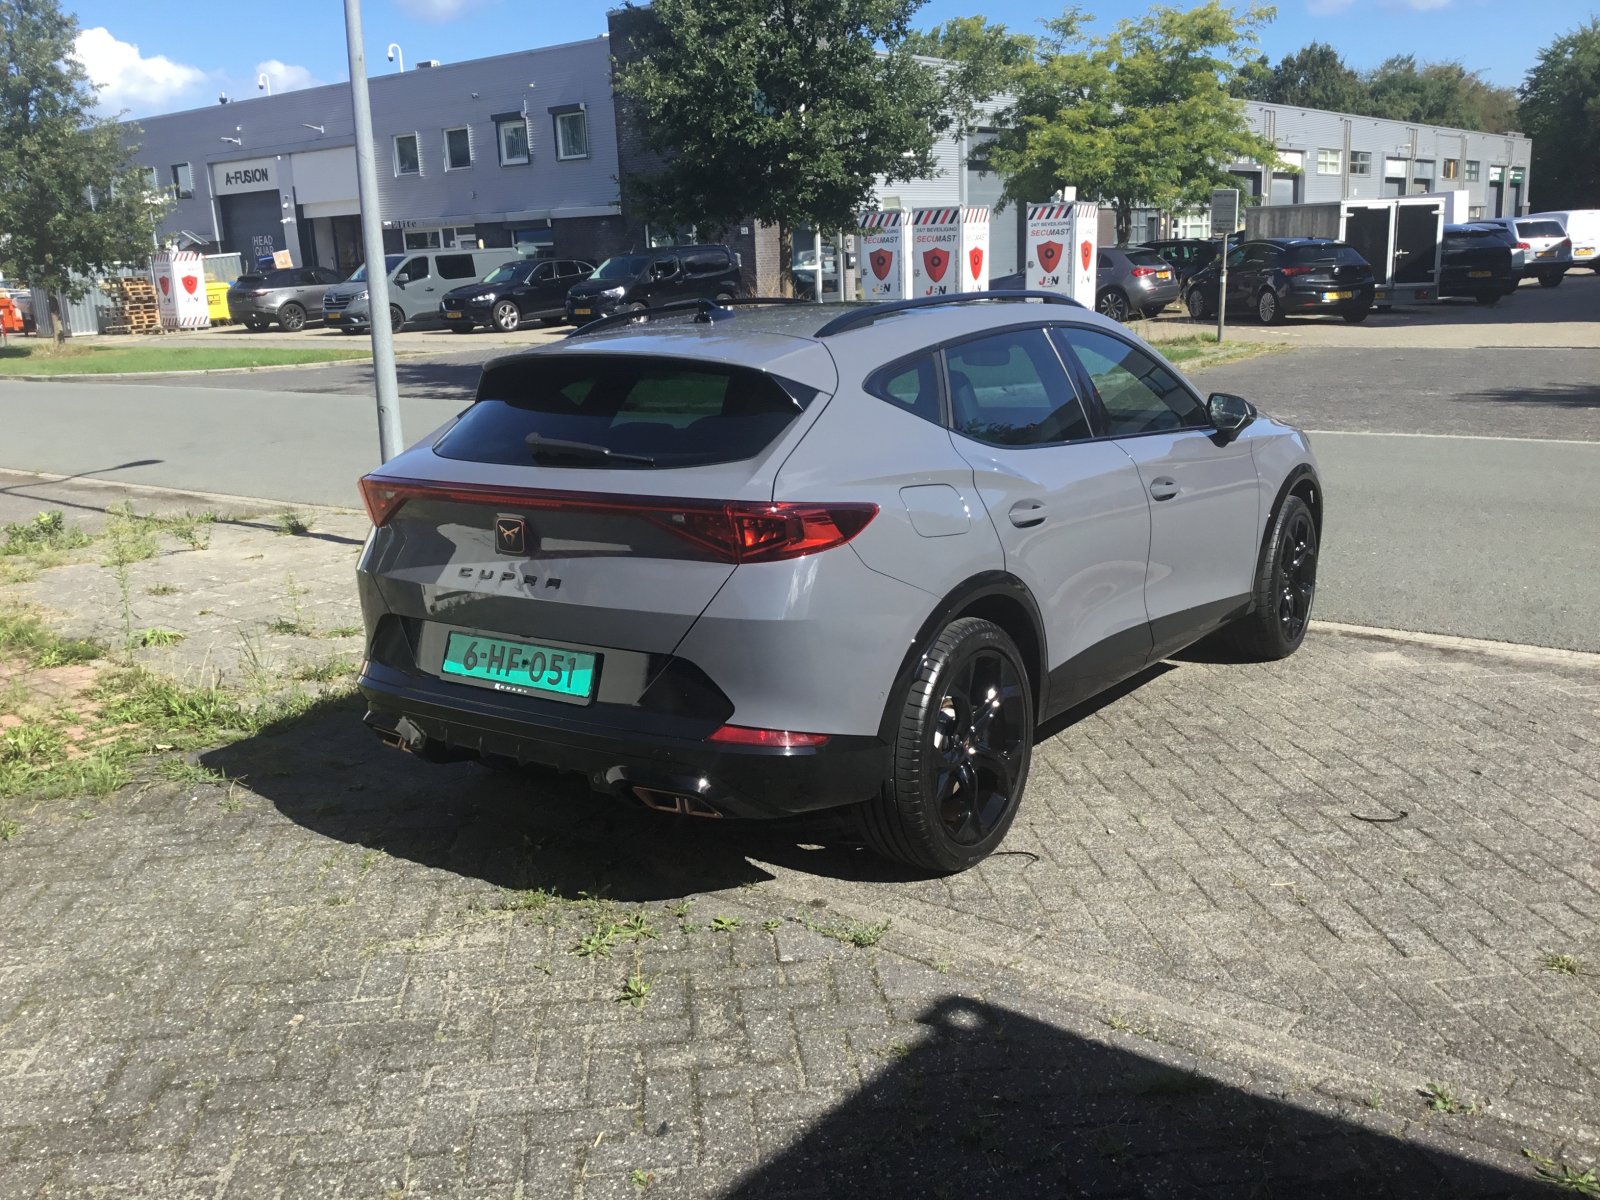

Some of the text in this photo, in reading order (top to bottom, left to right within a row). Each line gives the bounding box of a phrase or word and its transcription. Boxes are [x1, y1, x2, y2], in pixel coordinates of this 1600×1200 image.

[225, 167, 269, 186] A-FUSION
[1030, 228, 1071, 237] SECUMAST
[253, 235, 274, 246] HEAD
[863, 236, 899, 244] SECUMAST
[916, 234, 957, 243] SECUMAST
[459, 567, 562, 590] CUPRA
[463, 641, 576, 688] 6-HF-051
